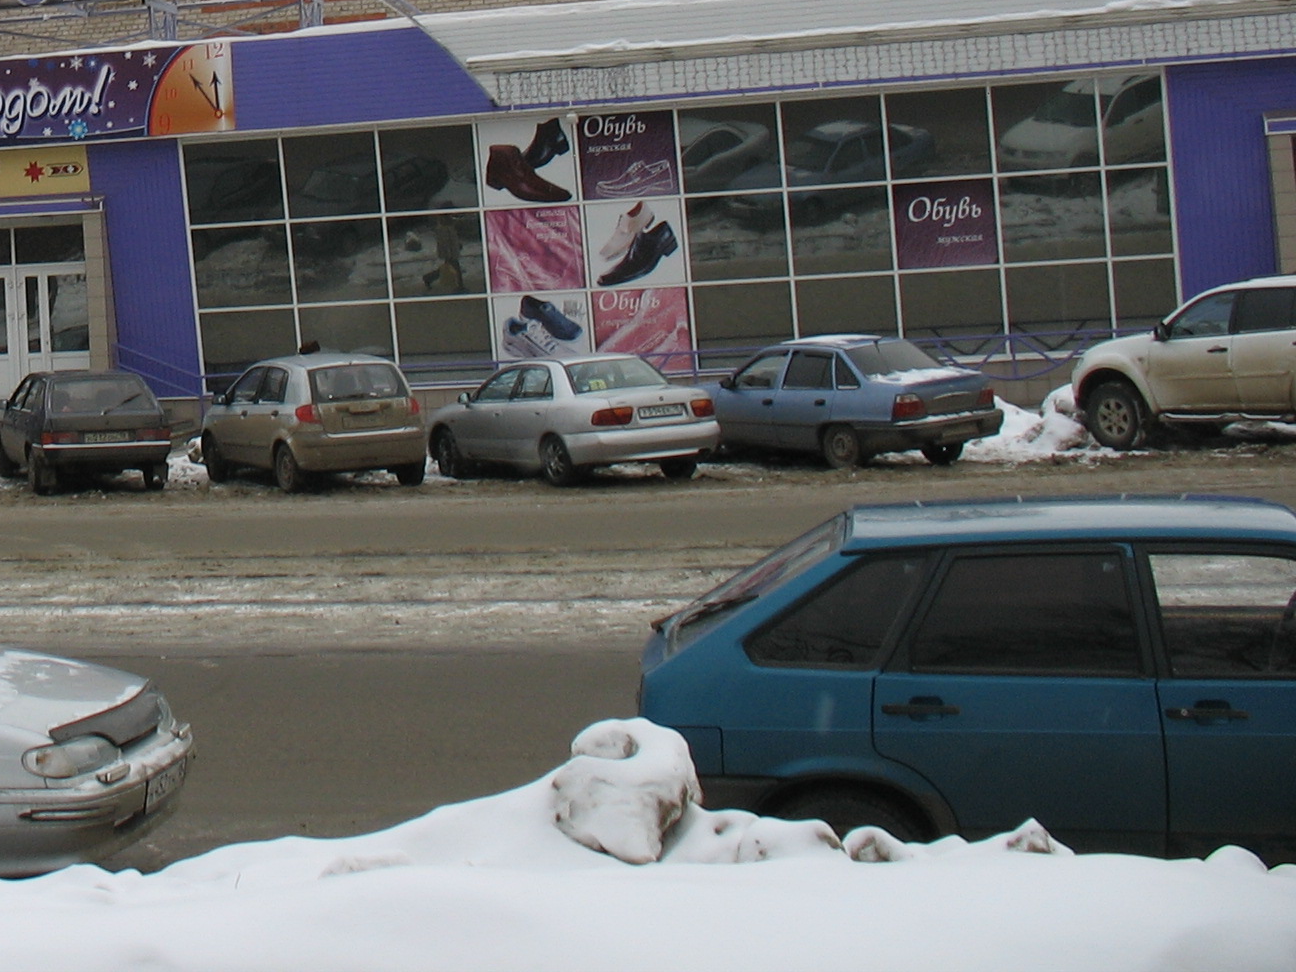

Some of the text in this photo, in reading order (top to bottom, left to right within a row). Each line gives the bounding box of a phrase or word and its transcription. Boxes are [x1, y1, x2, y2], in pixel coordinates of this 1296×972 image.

[205, 42, 223, 60] 12
[584, 114, 647, 142] Обувь
[908, 196, 982, 228] Обувь
